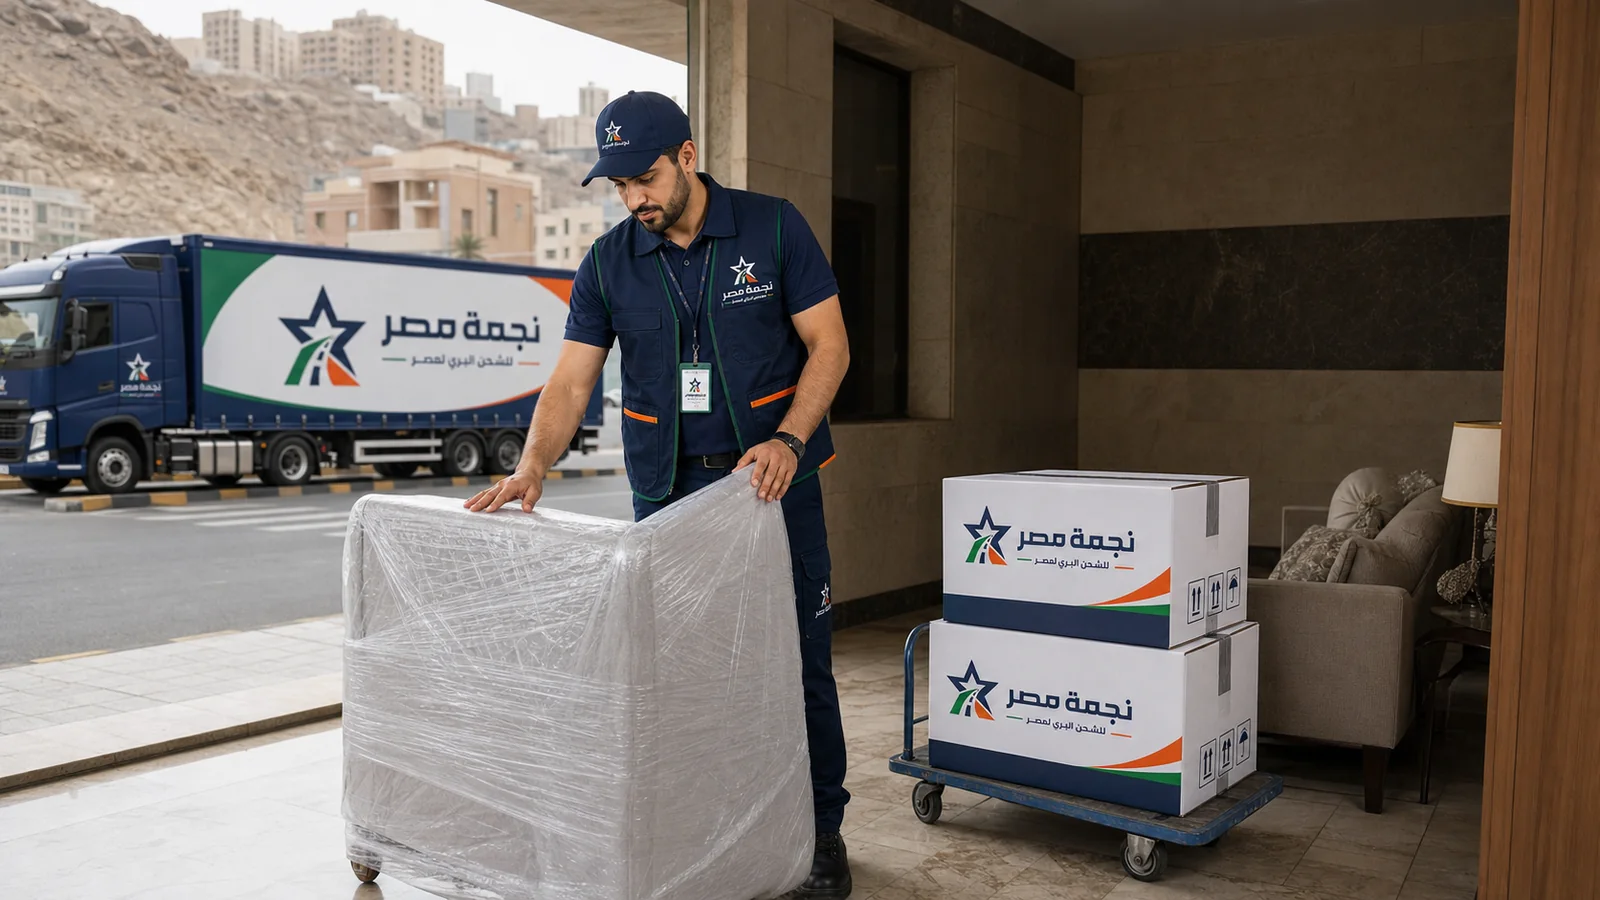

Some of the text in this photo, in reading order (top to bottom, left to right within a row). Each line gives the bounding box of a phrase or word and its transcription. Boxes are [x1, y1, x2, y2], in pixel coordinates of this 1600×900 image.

[722, 289, 745, 301] مصر
[745, 281, 773, 294] نجمة
[381, 311, 540, 351] نجمة مصر
[448, 354, 475, 370] البري
[477, 355, 513, 368] للشحن
[1017, 528, 1134, 558] نجمة مصر
[1034, 557, 1110, 570] للشحن البري لمصر
[1006, 689, 1132, 725] نجمة مصر
[1026, 717, 1106, 735] للشحن البري لمصر
